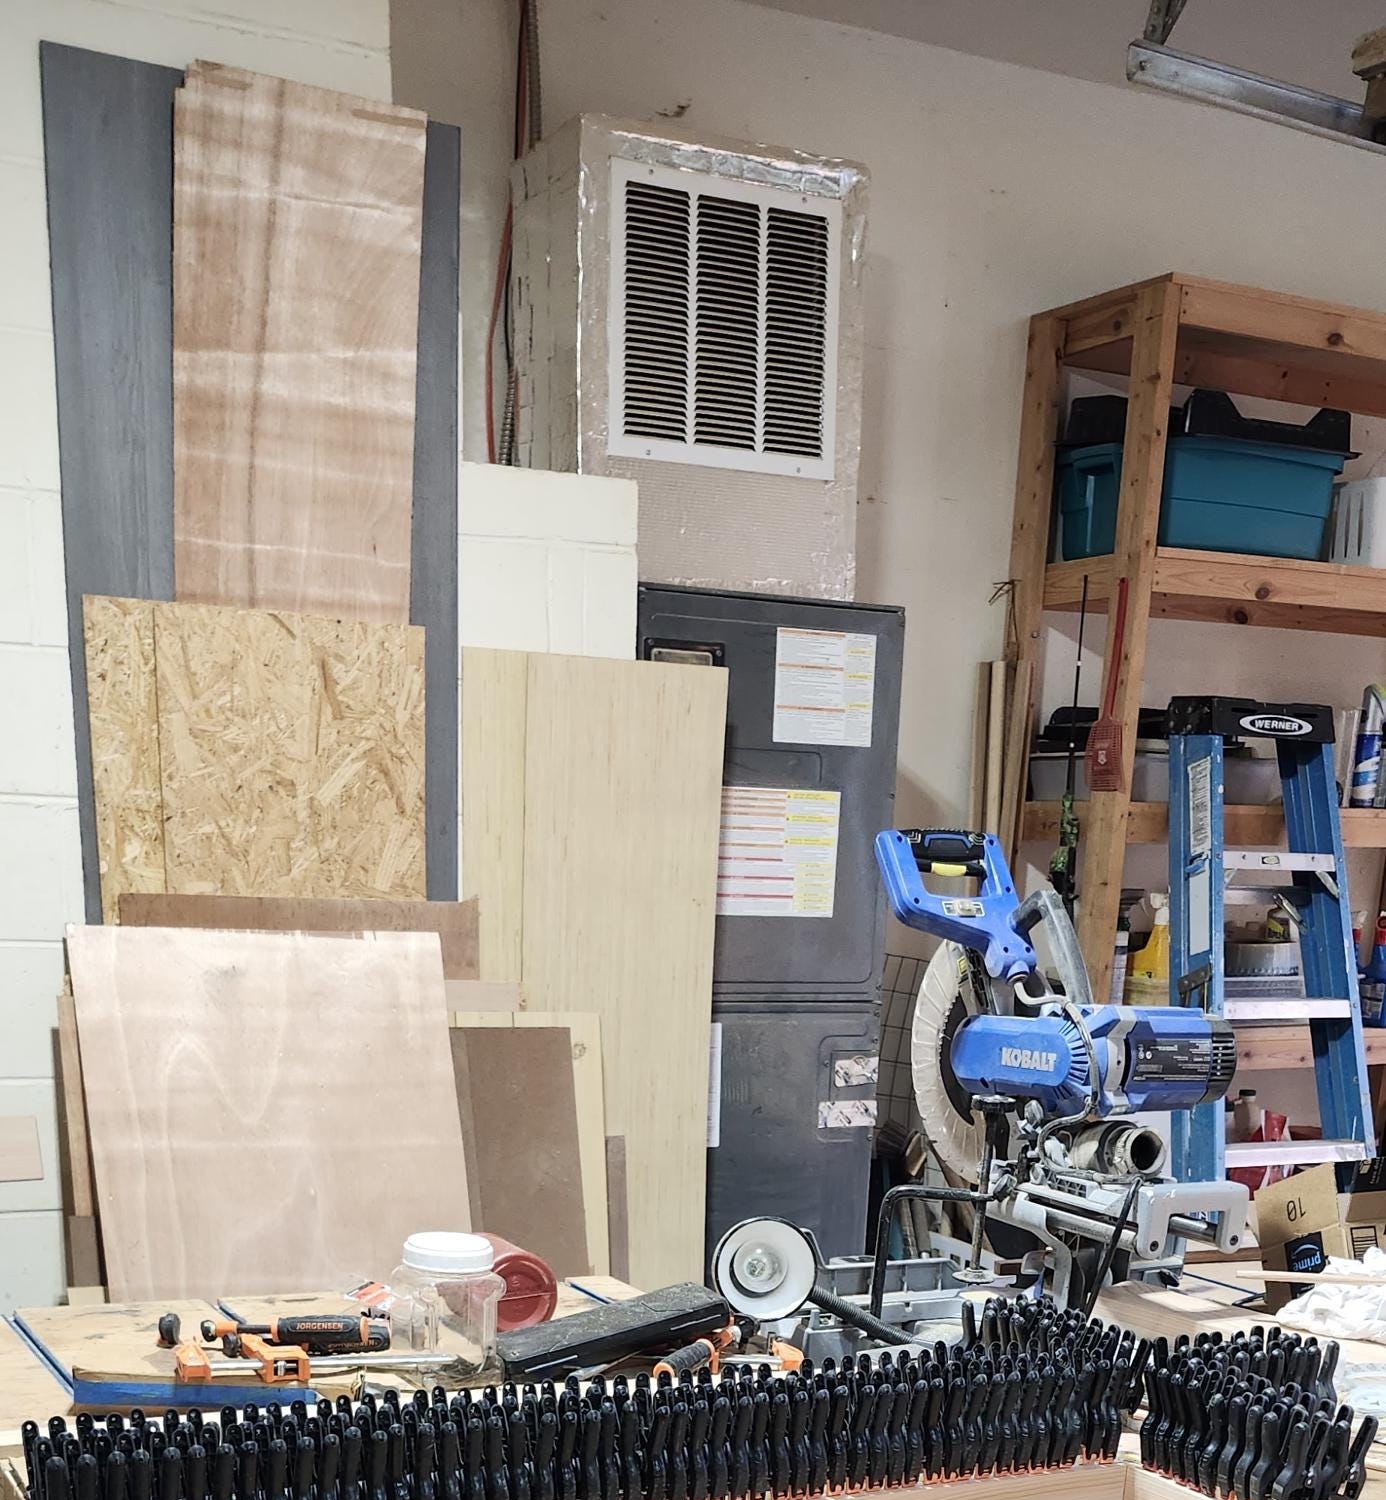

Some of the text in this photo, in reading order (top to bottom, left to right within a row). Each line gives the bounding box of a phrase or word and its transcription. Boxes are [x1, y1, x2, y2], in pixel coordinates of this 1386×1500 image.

[1254, 719, 1300, 731] WERNER
[1001, 1046, 1057, 1072] KOBALT
[1286, 1197, 1306, 1222] 10
[1292, 1251, 1322, 1272] prime
[296, 1322, 344, 1331] JORGENSEN
